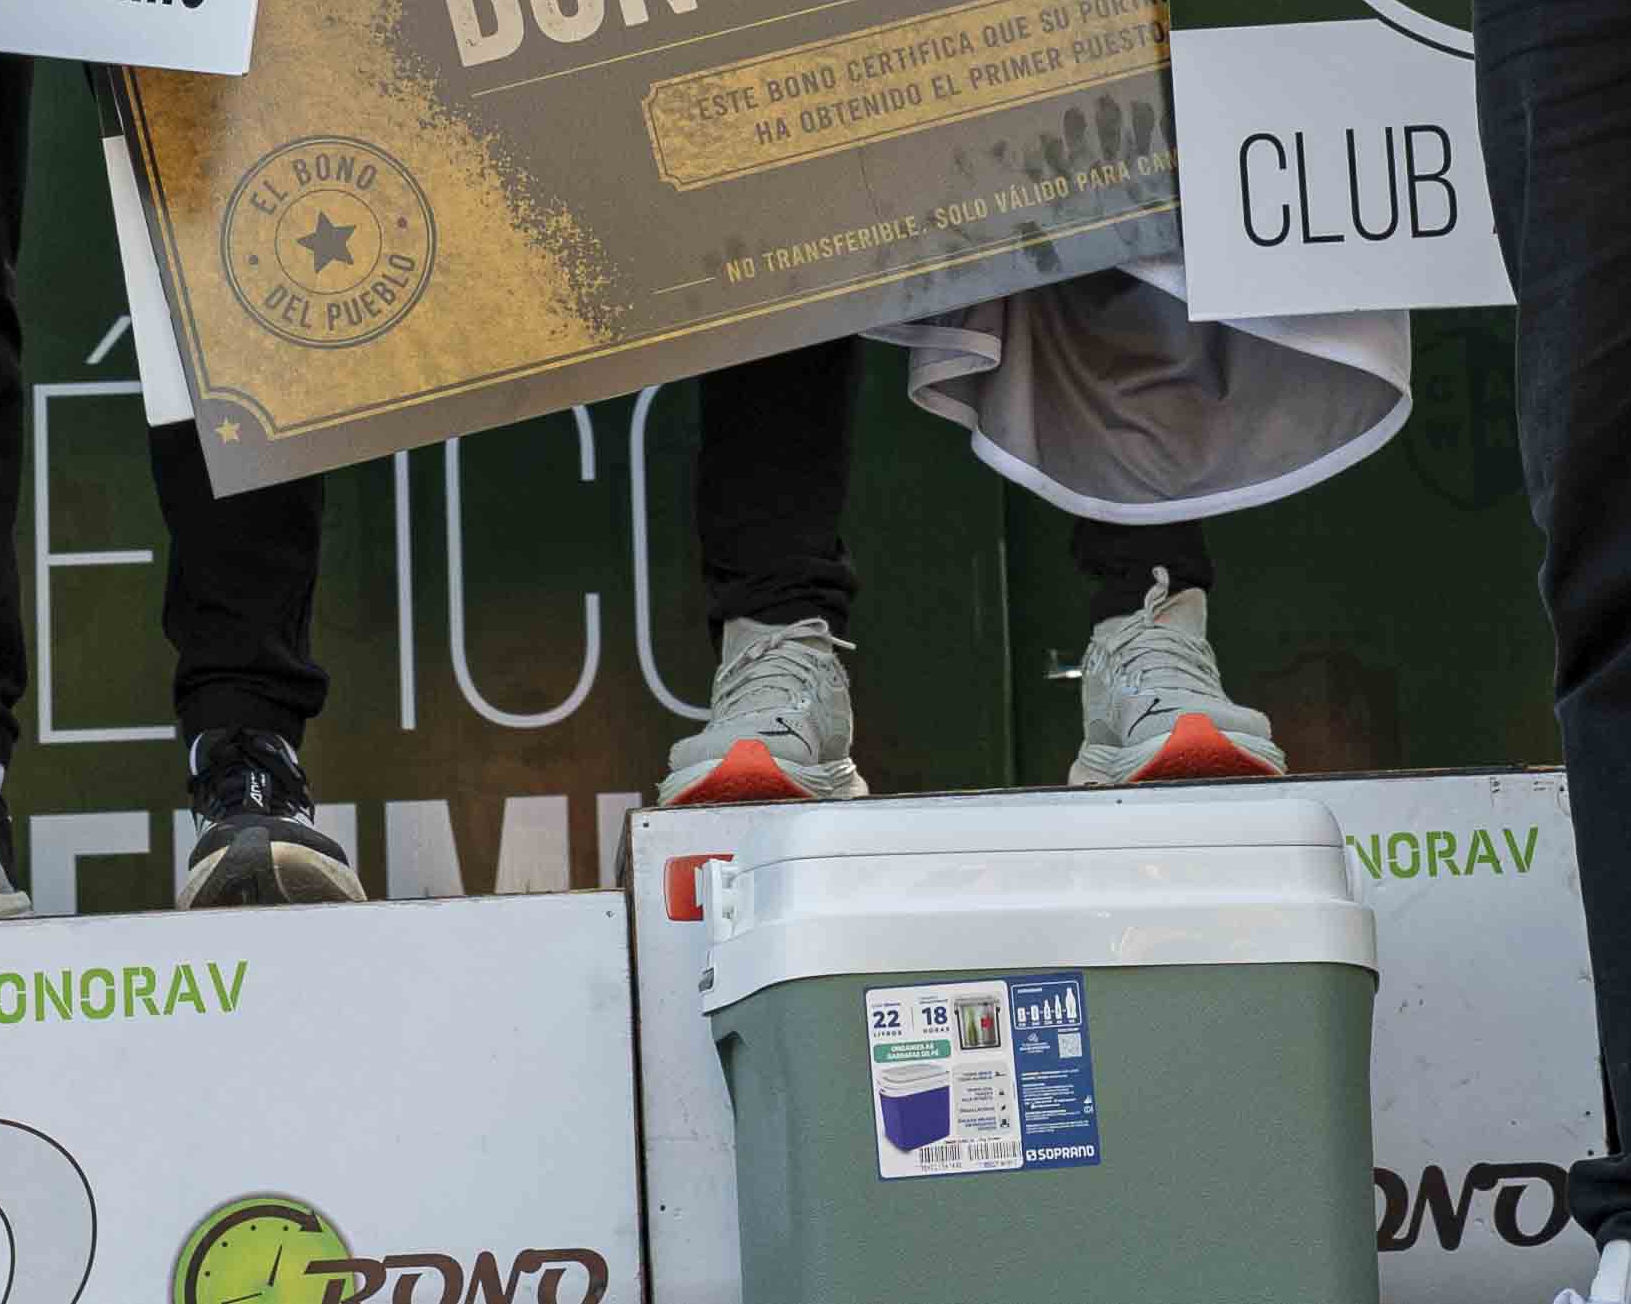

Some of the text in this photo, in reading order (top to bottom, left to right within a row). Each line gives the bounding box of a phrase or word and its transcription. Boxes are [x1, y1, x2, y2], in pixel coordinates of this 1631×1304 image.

[698, 93, 759, 120] ESTE
[768, 70, 837, 105] BONO
[848, 31, 971, 86] CERTIFICA
[983, 14, 1033, 48] QUE
[1040, 7, 1072, 33] SU
[756, 117, 790, 145] HA
[800, 83, 922, 134] OBTENIDO
[932, 74, 962, 98] EL
[970, 46, 1061, 90] PRIMER
[251, 155, 379, 215] EL BONO
[1239, 123, 1457, 248] CLUB
[726, 255, 755, 283] NO
[935, 201, 987, 229] SOLO
[994, 175, 1069, 218] VÁLIDO
[1075, 161, 1130, 194] PARA
[264, 252, 416, 332] DEL PUEBLO
[1346, 824, 1540, 881] NORAV
[873, 1010, 900, 1028] 22
[922, 1006, 947, 1025] 18
[1039, 1145, 1095, 1160] SOPRANO
